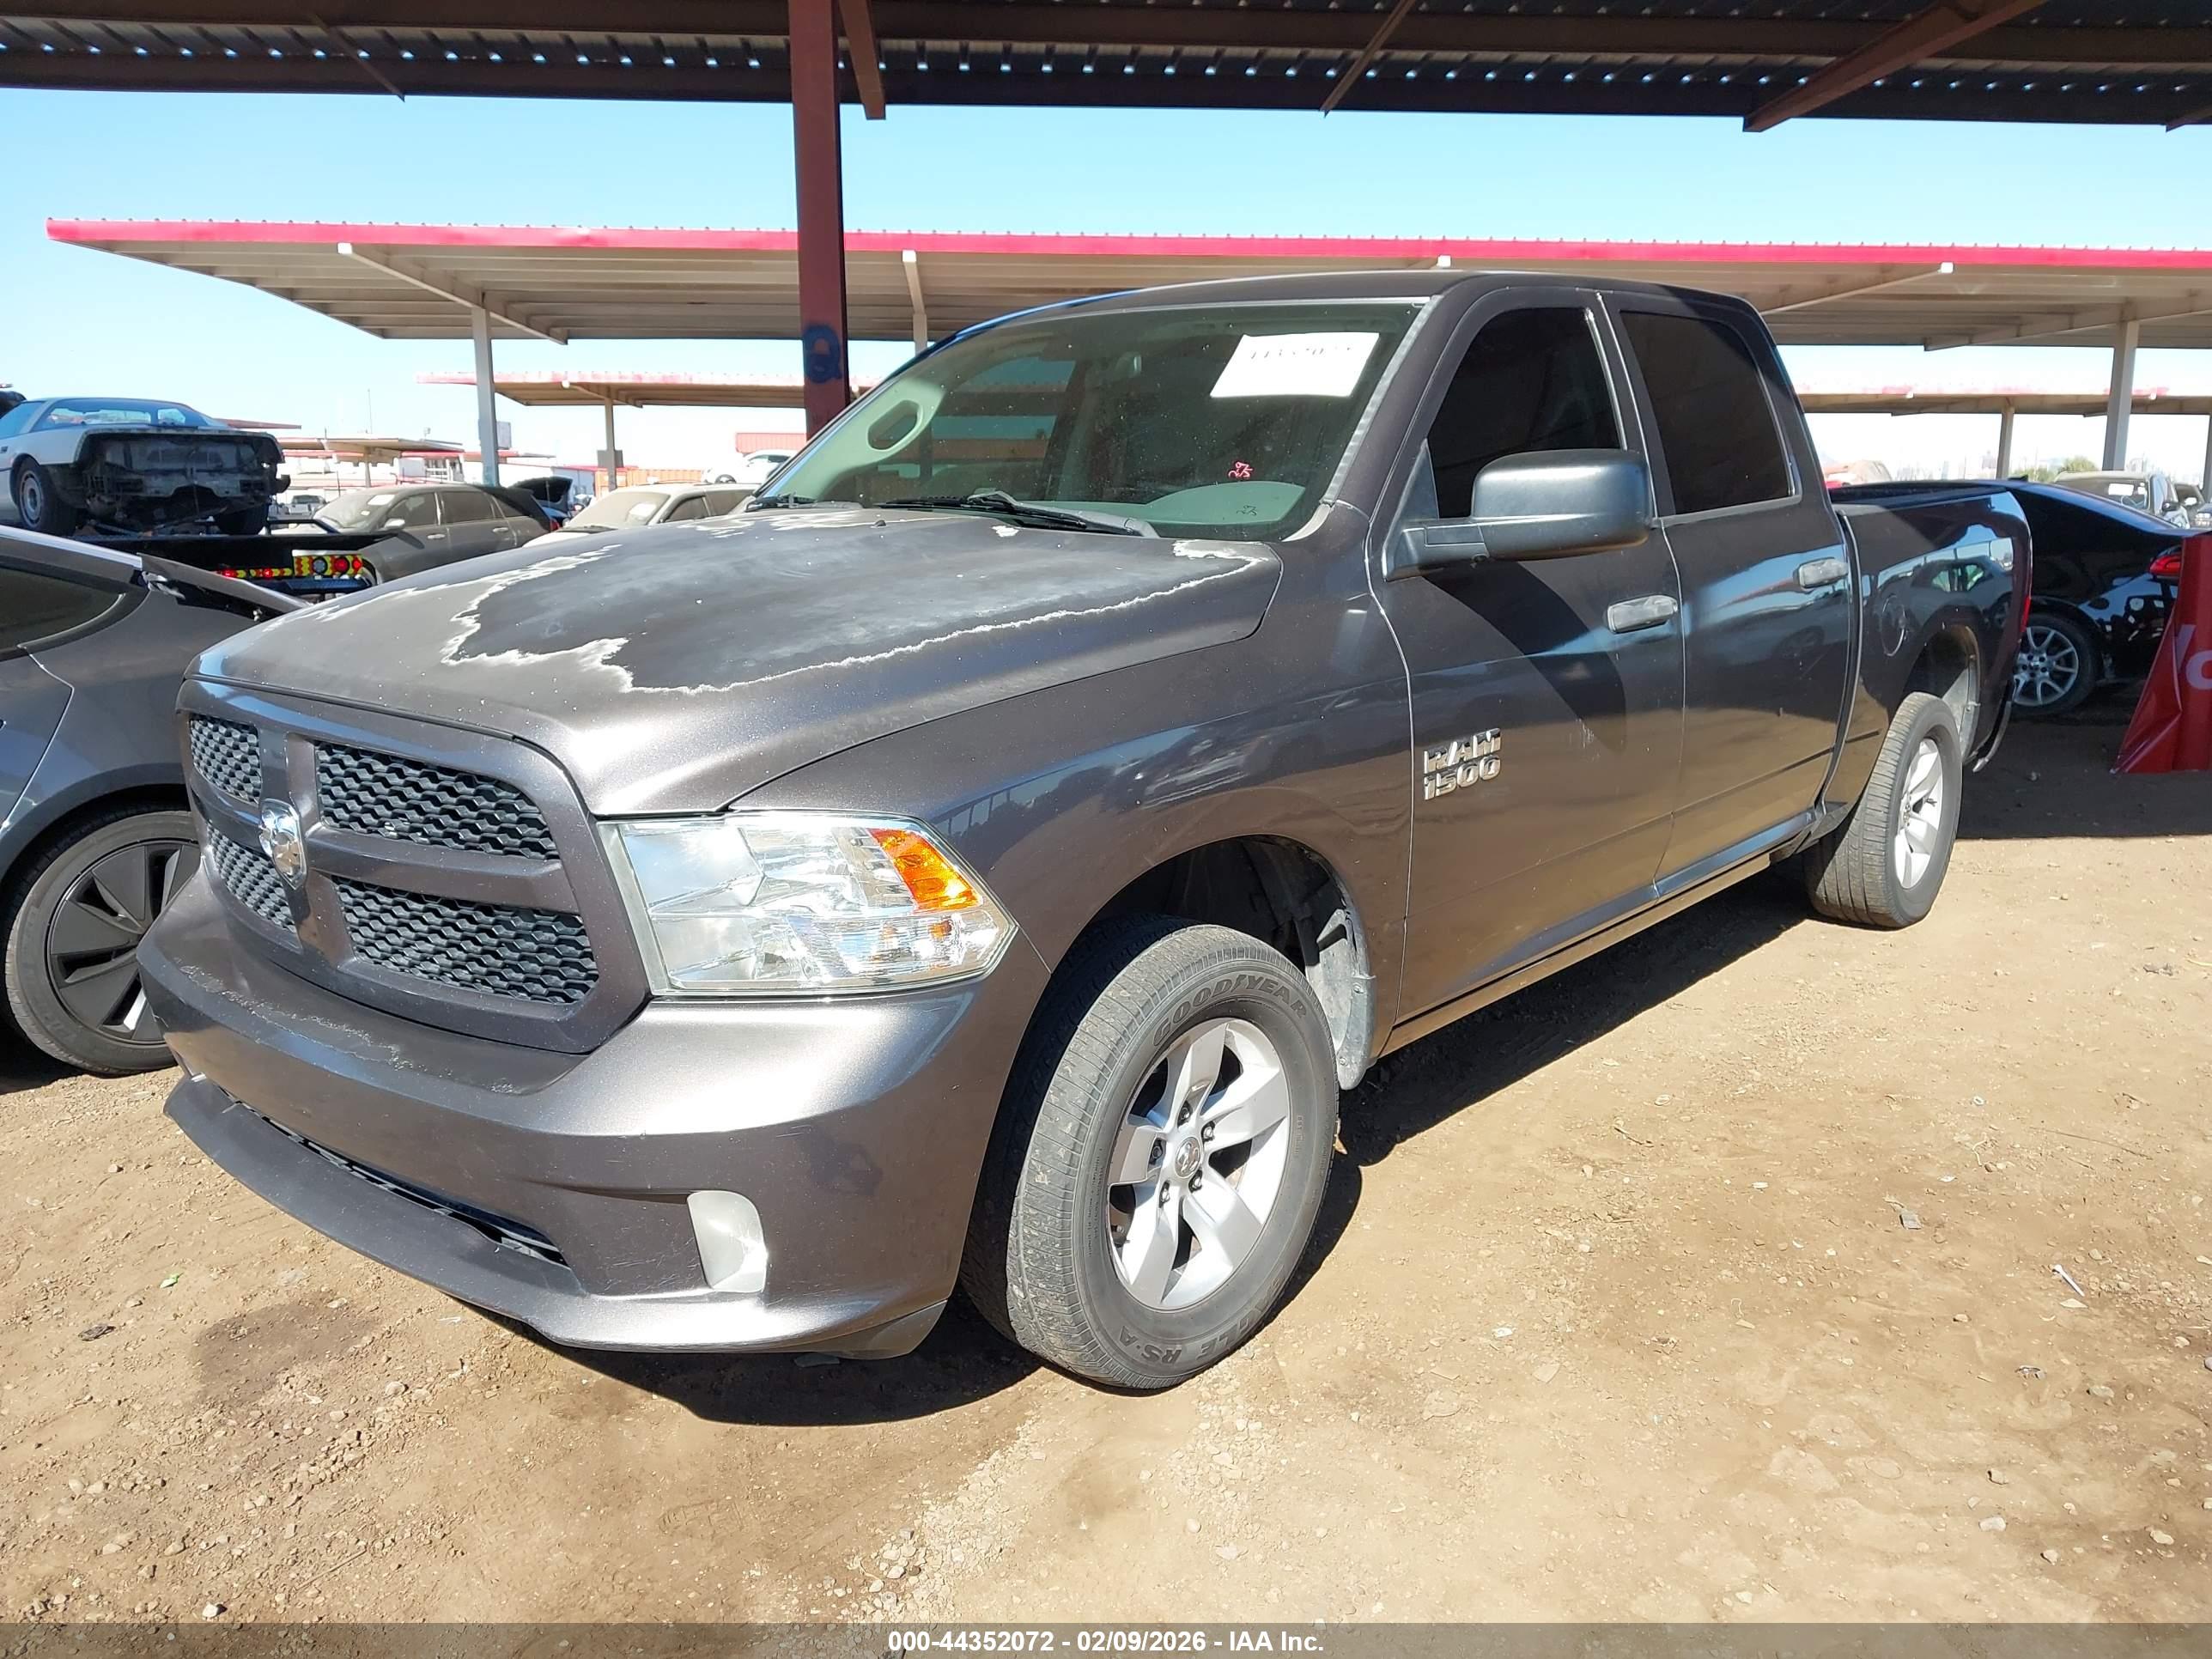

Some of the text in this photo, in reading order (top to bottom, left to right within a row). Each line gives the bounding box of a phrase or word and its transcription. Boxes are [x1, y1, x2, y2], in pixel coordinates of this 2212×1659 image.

[1424, 728, 1501, 774] RAM
[1424, 755, 1501, 800] 1500
[1153, 974, 1307, 1047] GOODYEAR
